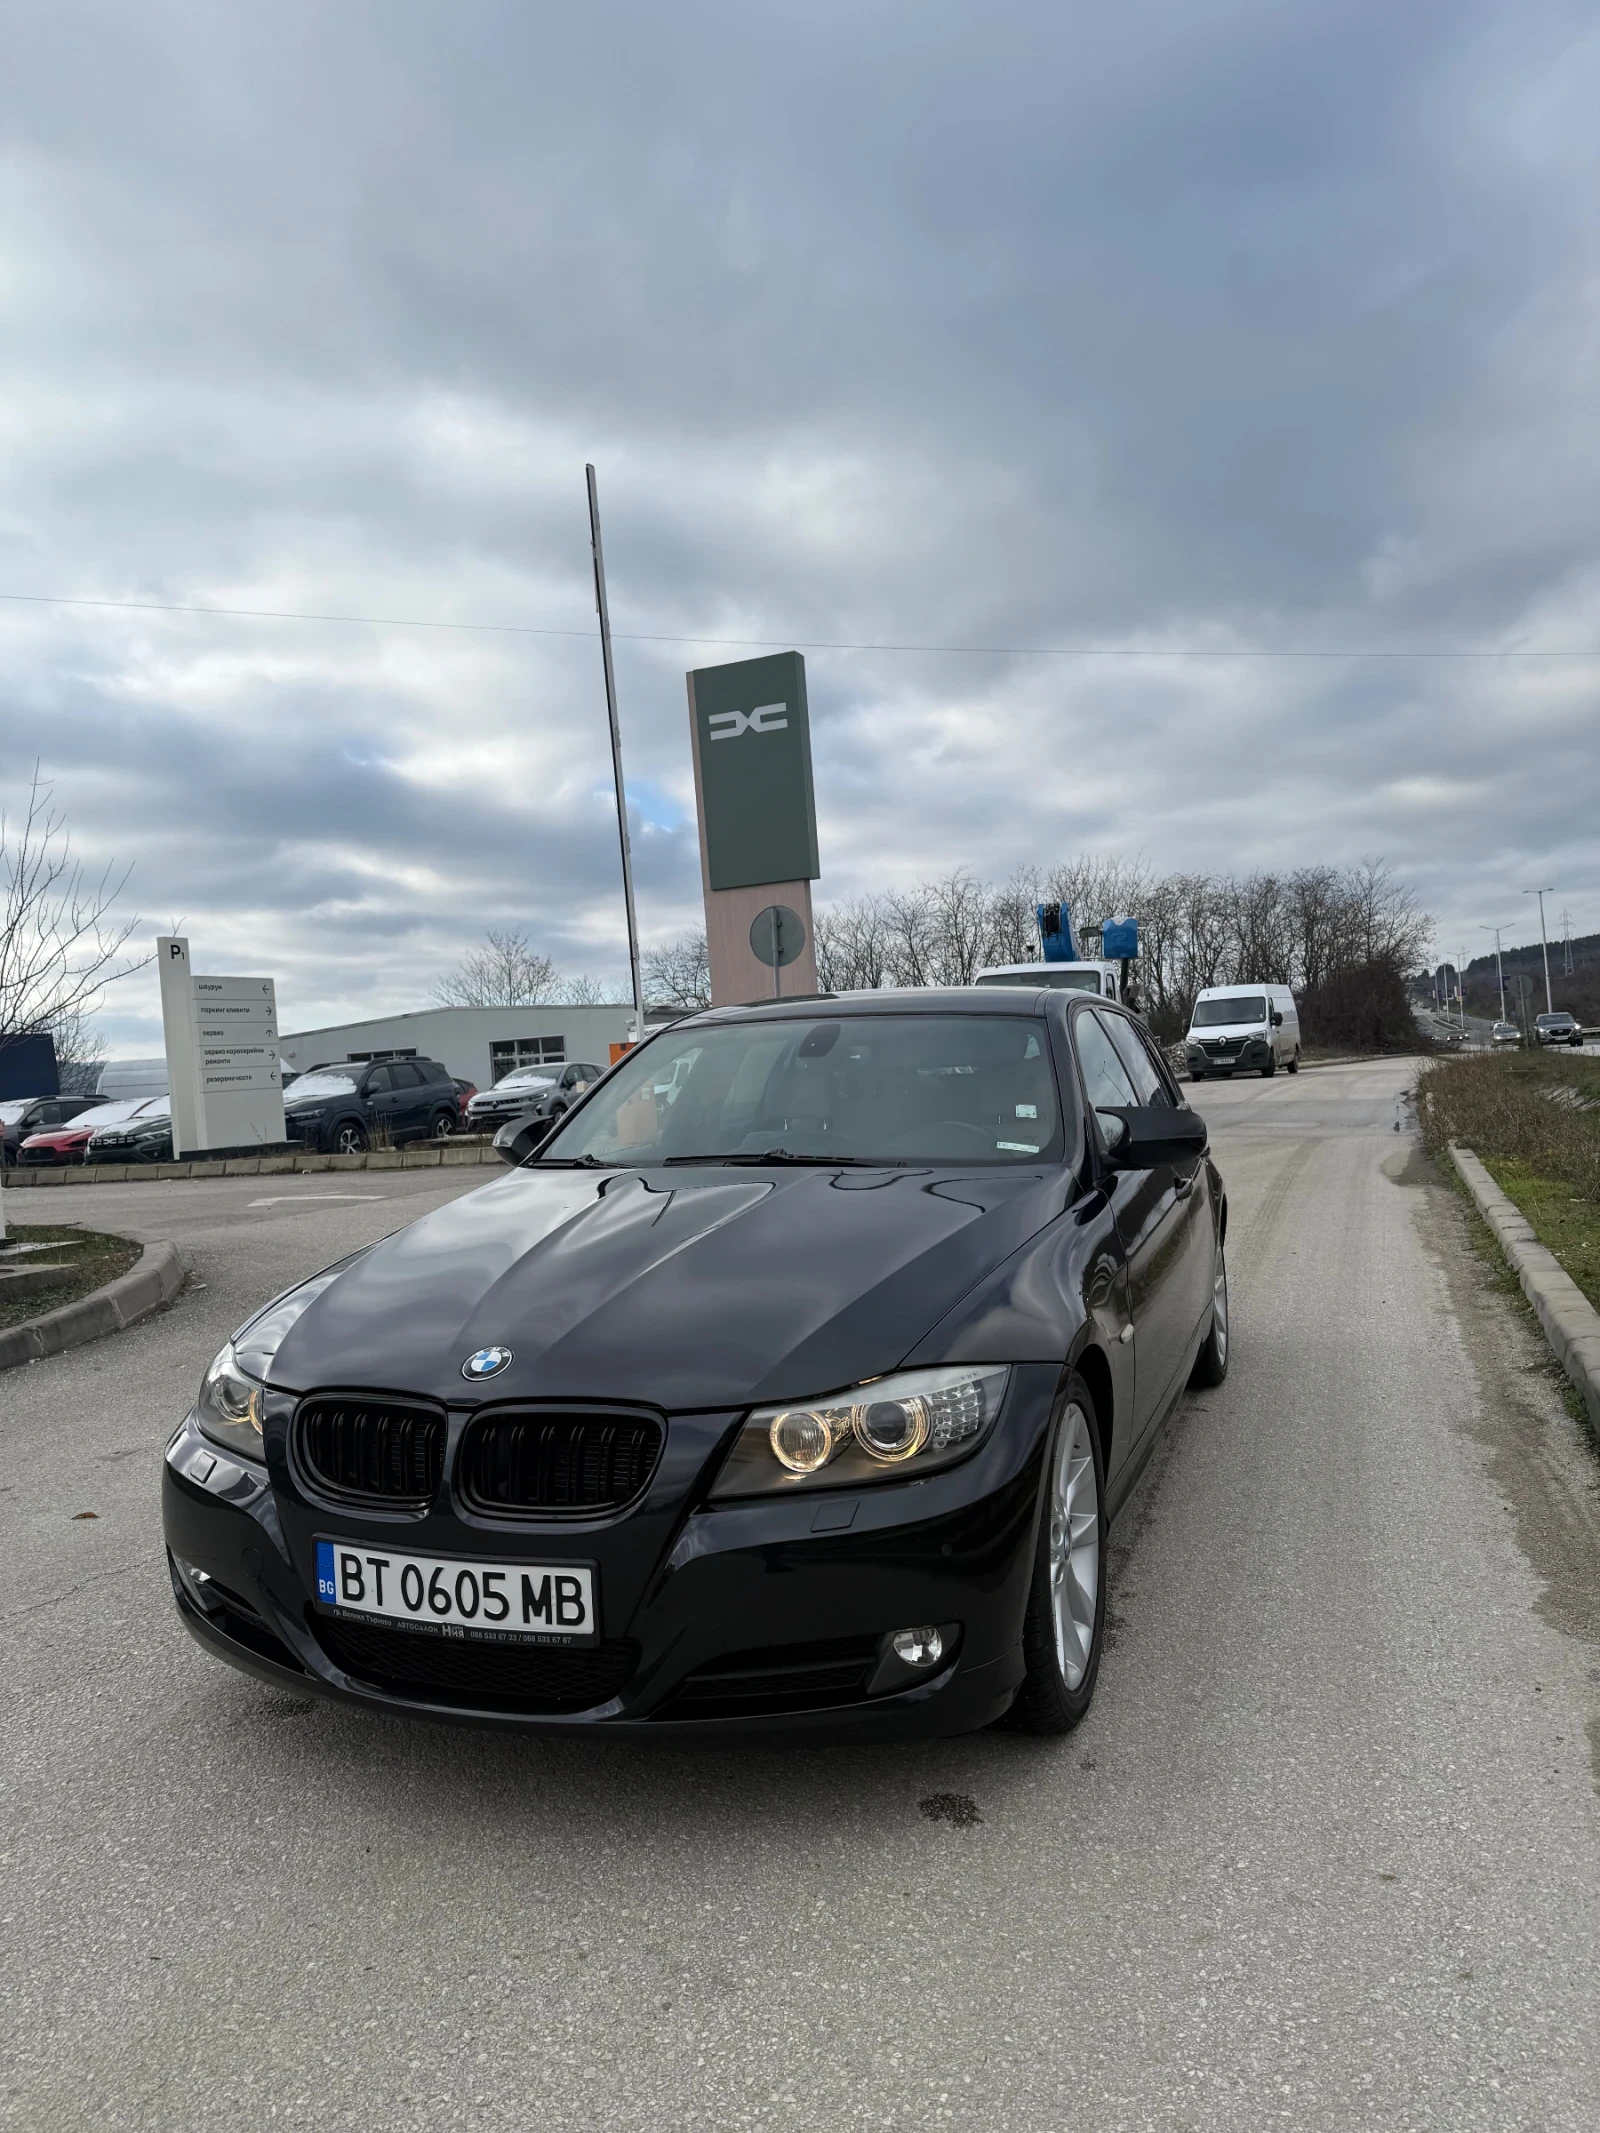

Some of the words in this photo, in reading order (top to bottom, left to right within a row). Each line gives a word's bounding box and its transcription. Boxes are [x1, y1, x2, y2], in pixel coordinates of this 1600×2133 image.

[198, 984, 223, 992] шоурум
[200, 1007, 225, 1015] паркинг
[205, 1058, 231, 1066] ремонти
[206, 1075, 235, 1085] резервни
[318, 1579, 335, 1595] BG
[340, 1552, 390, 1607] BT
[400, 1563, 510, 1622] 0605
[521, 1573, 587, 1627] MB
[333, 1608, 342, 1617] гр.
[342, 1610, 366, 1621] Велико
[365, 1614, 392, 1627] Търново
[396, 1621, 439, 1634] АВТОСАЛОН
[470, 1631, 483, 1639] 088
[484, 1632, 497, 1640] 533
[498, 1633, 507, 1641] 67
[508, 1634, 518, 1642] 23
[522, 1635, 536, 1643] 088
[552, 1636, 561, 1644] 67
[562, 1636, 572, 1644] 87
